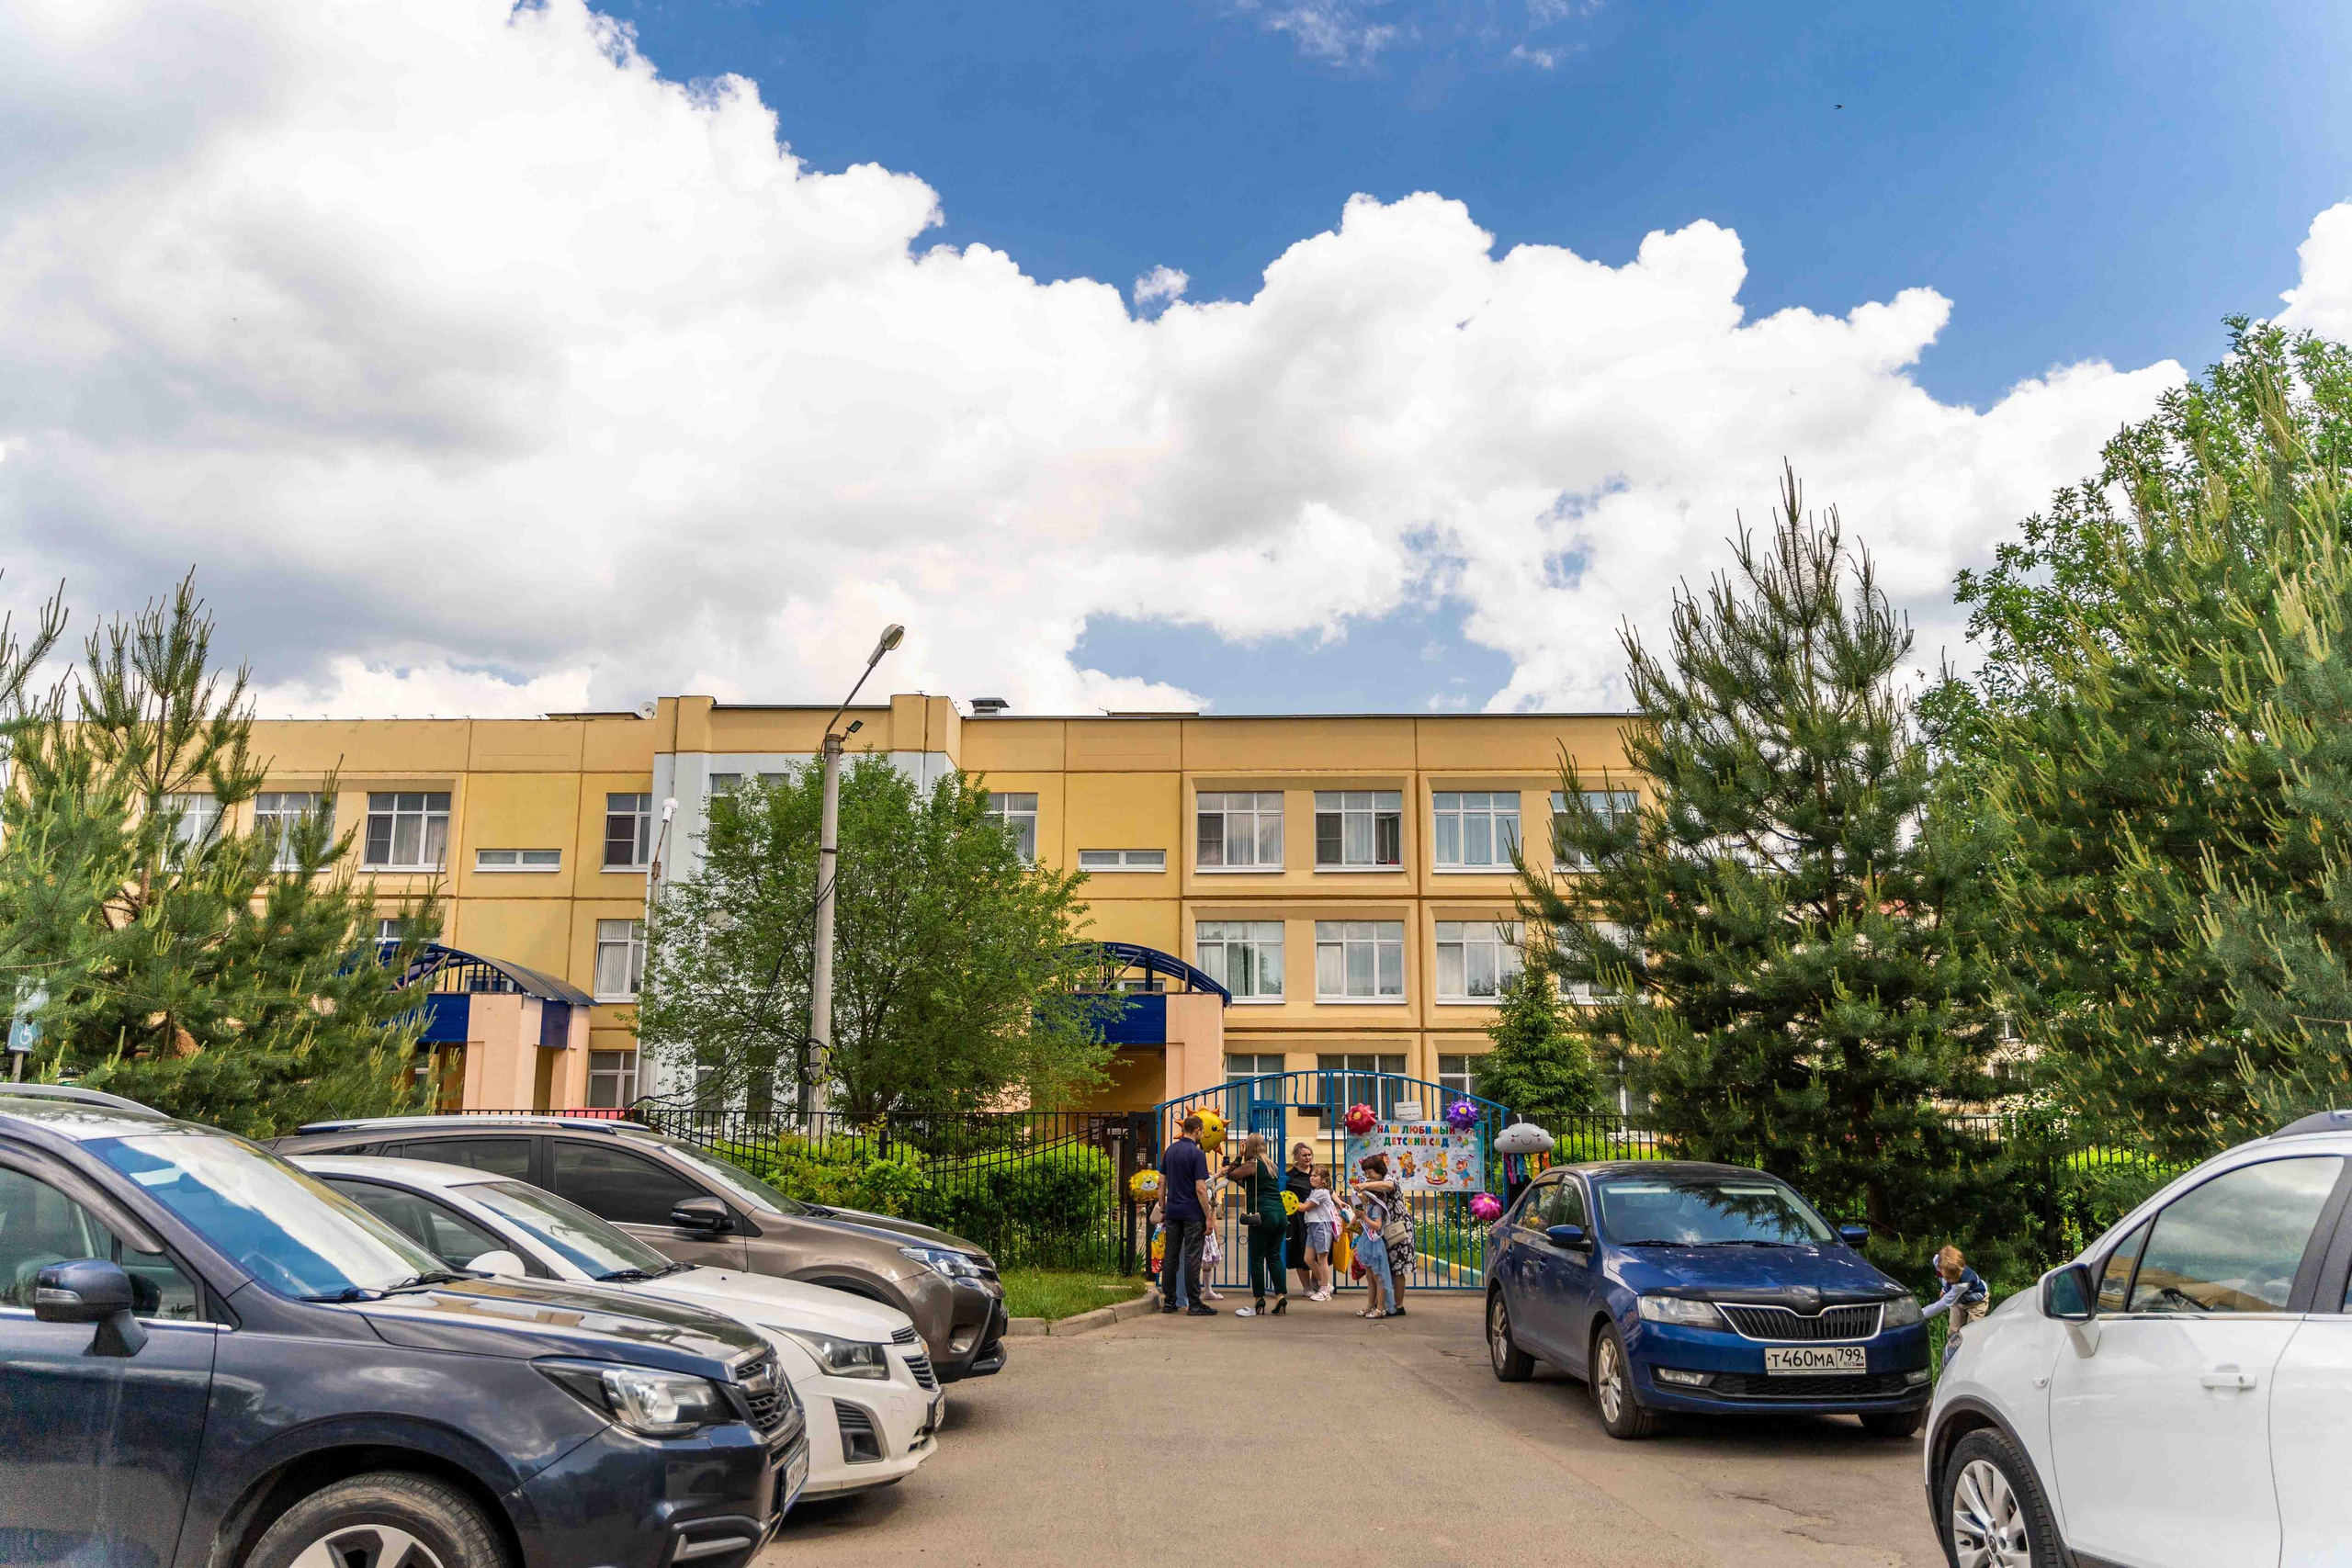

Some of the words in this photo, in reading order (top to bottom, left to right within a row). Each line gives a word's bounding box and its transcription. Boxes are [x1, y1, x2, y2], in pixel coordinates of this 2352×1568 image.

[1377, 1124, 1399, 1134] НАШ
[1384, 1135, 1426, 1146] ДЕТСКИЙ
[1430, 1137, 1449, 1148] САД
[1837, 1348, 1860, 1361] 799
